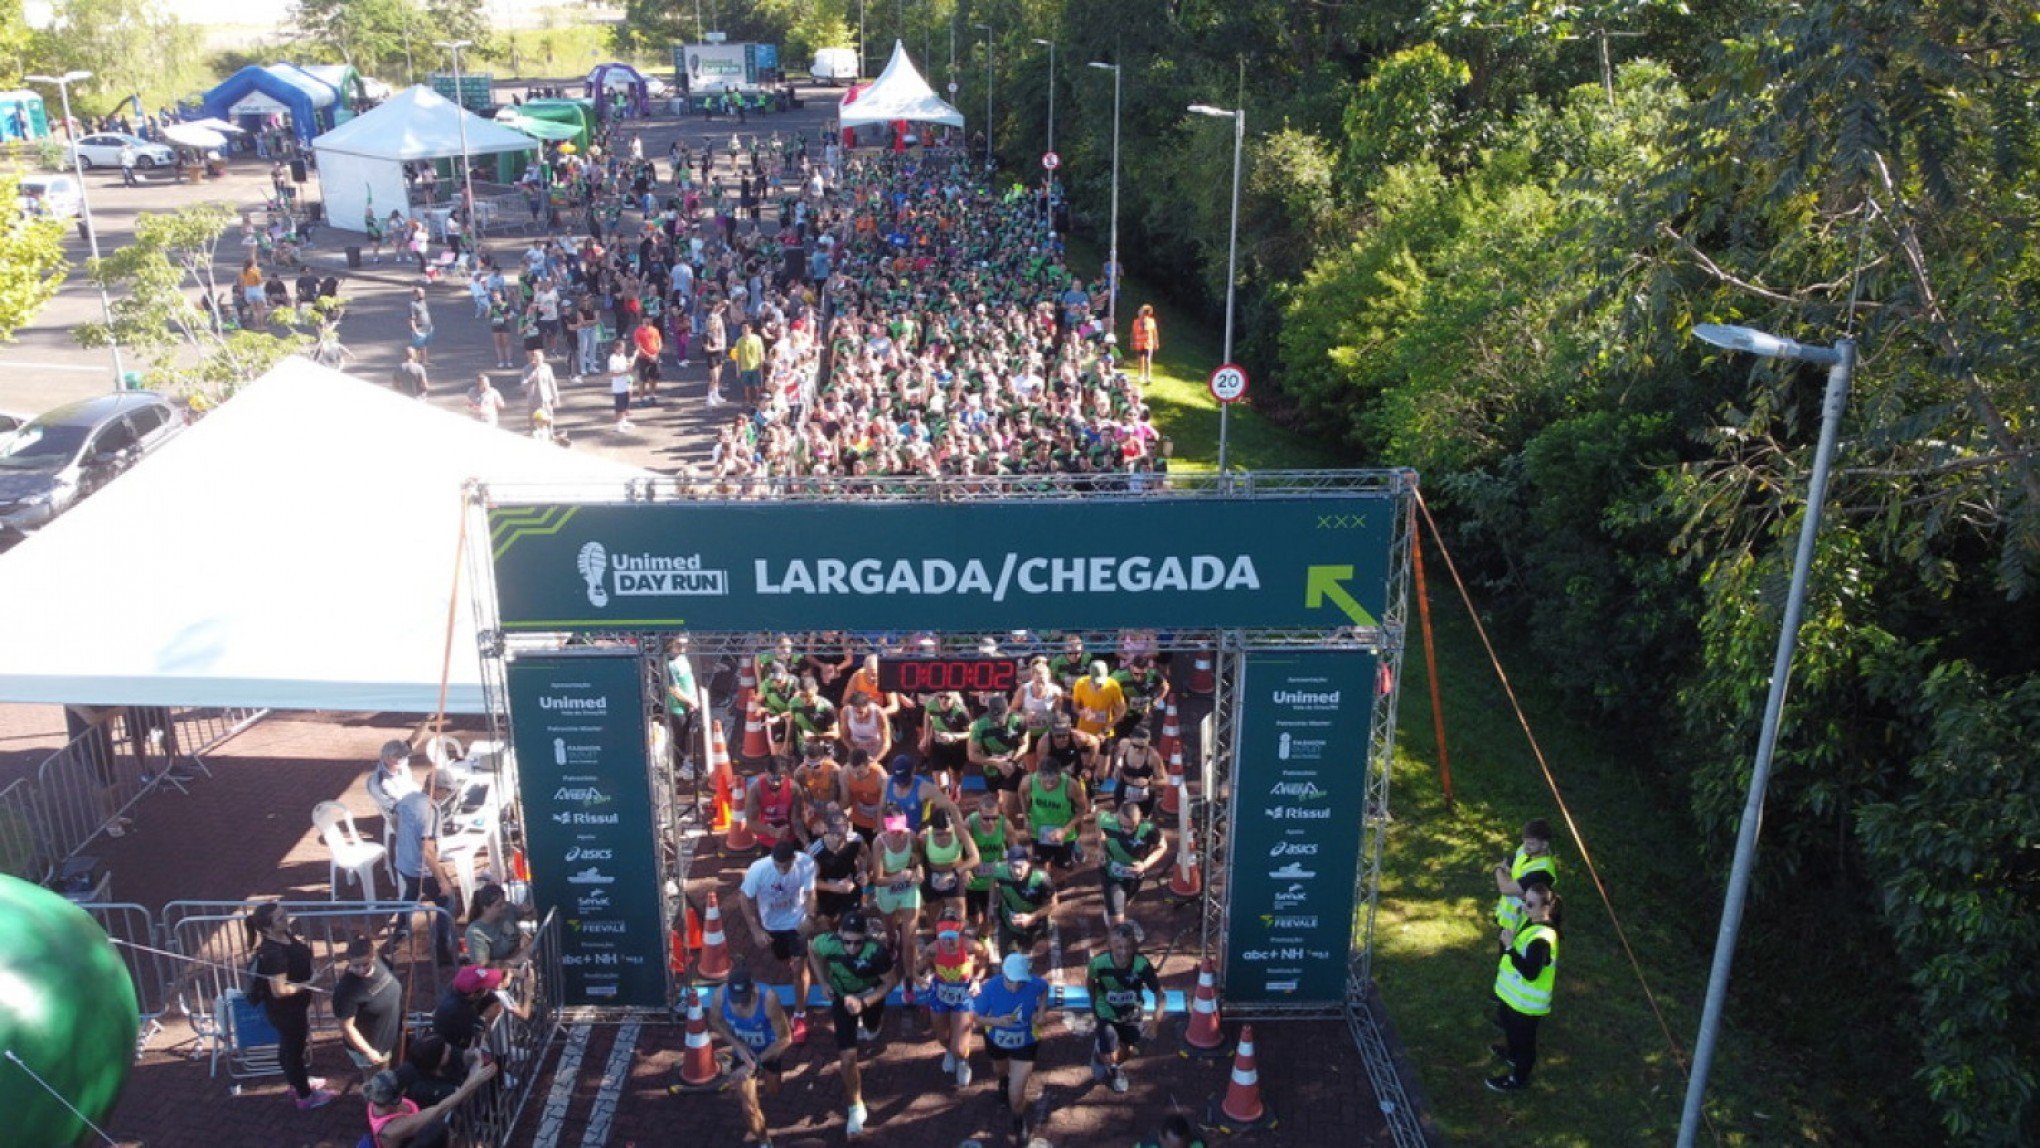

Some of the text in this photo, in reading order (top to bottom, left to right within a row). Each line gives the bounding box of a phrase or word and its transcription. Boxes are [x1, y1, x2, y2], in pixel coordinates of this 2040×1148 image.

[1217, 373, 1239, 388] 20
[611, 553, 700, 571] Unimed
[619, 574, 718, 592] DAY RUN
[754, 553, 1260, 601] LARGADA/CHEGADA
[901, 661, 1015, 689] 0:00:02
[539, 696, 607, 709] Unimed
[1272, 690, 1340, 704] Unimed
[573, 812, 620, 825] Rissul
[1285, 807, 1331, 819] Rissul
